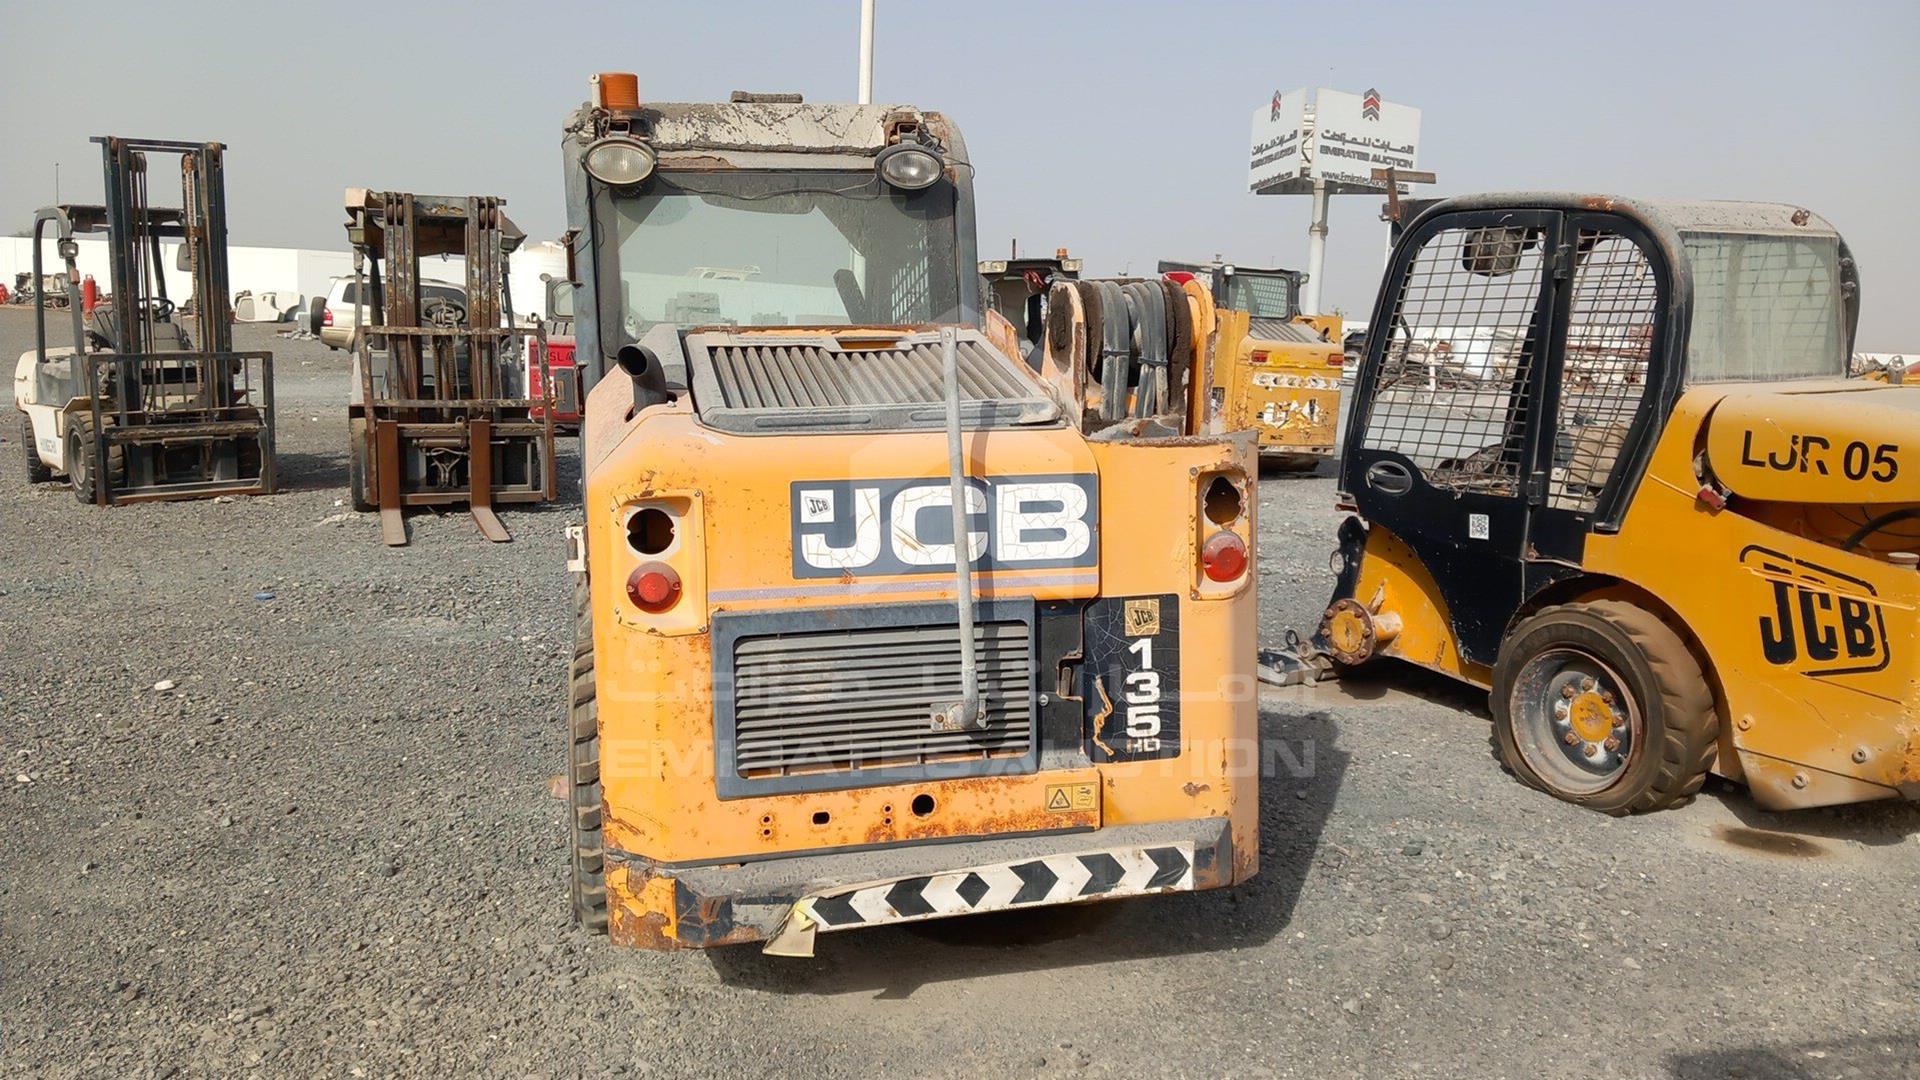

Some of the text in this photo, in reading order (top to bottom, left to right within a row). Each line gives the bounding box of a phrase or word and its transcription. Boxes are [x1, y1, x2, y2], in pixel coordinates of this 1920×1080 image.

[1320, 145, 1413, 168] EMIRATES AUCTION
[1742, 430, 1898, 482] LJR 05
[809, 499, 829, 514] JCB
[801, 482, 1091, 569] JCB
[1134, 609, 1155, 626] JCB
[1759, 562, 1876, 665] JCB
[1126, 637, 1161, 738] 135
[1127, 737, 1161, 753] HD
